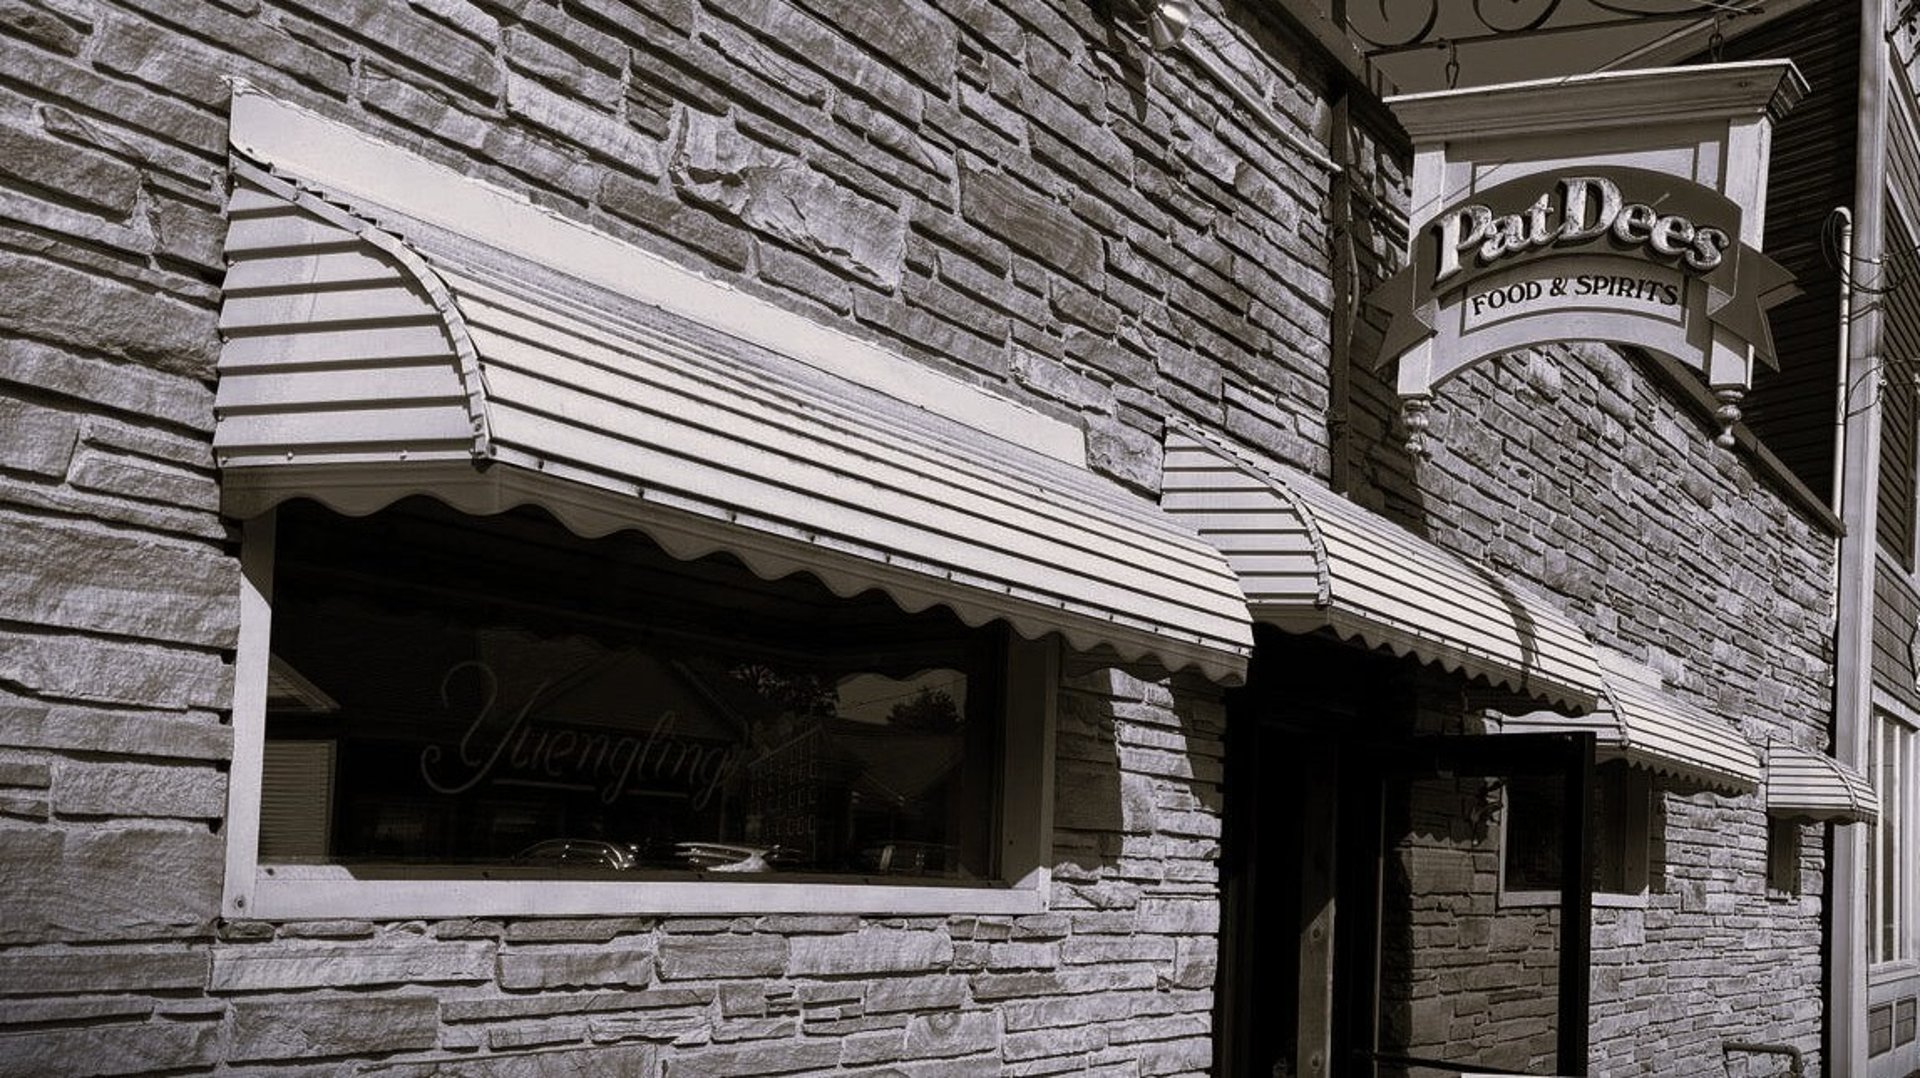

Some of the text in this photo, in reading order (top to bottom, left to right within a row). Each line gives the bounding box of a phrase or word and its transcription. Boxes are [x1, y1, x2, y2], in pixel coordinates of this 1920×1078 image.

[1432, 176, 1731, 284] Pat Dees
[1472, 274, 1679, 317] FOOD & SPIRITS
[420, 659, 736, 812] Yuengling
